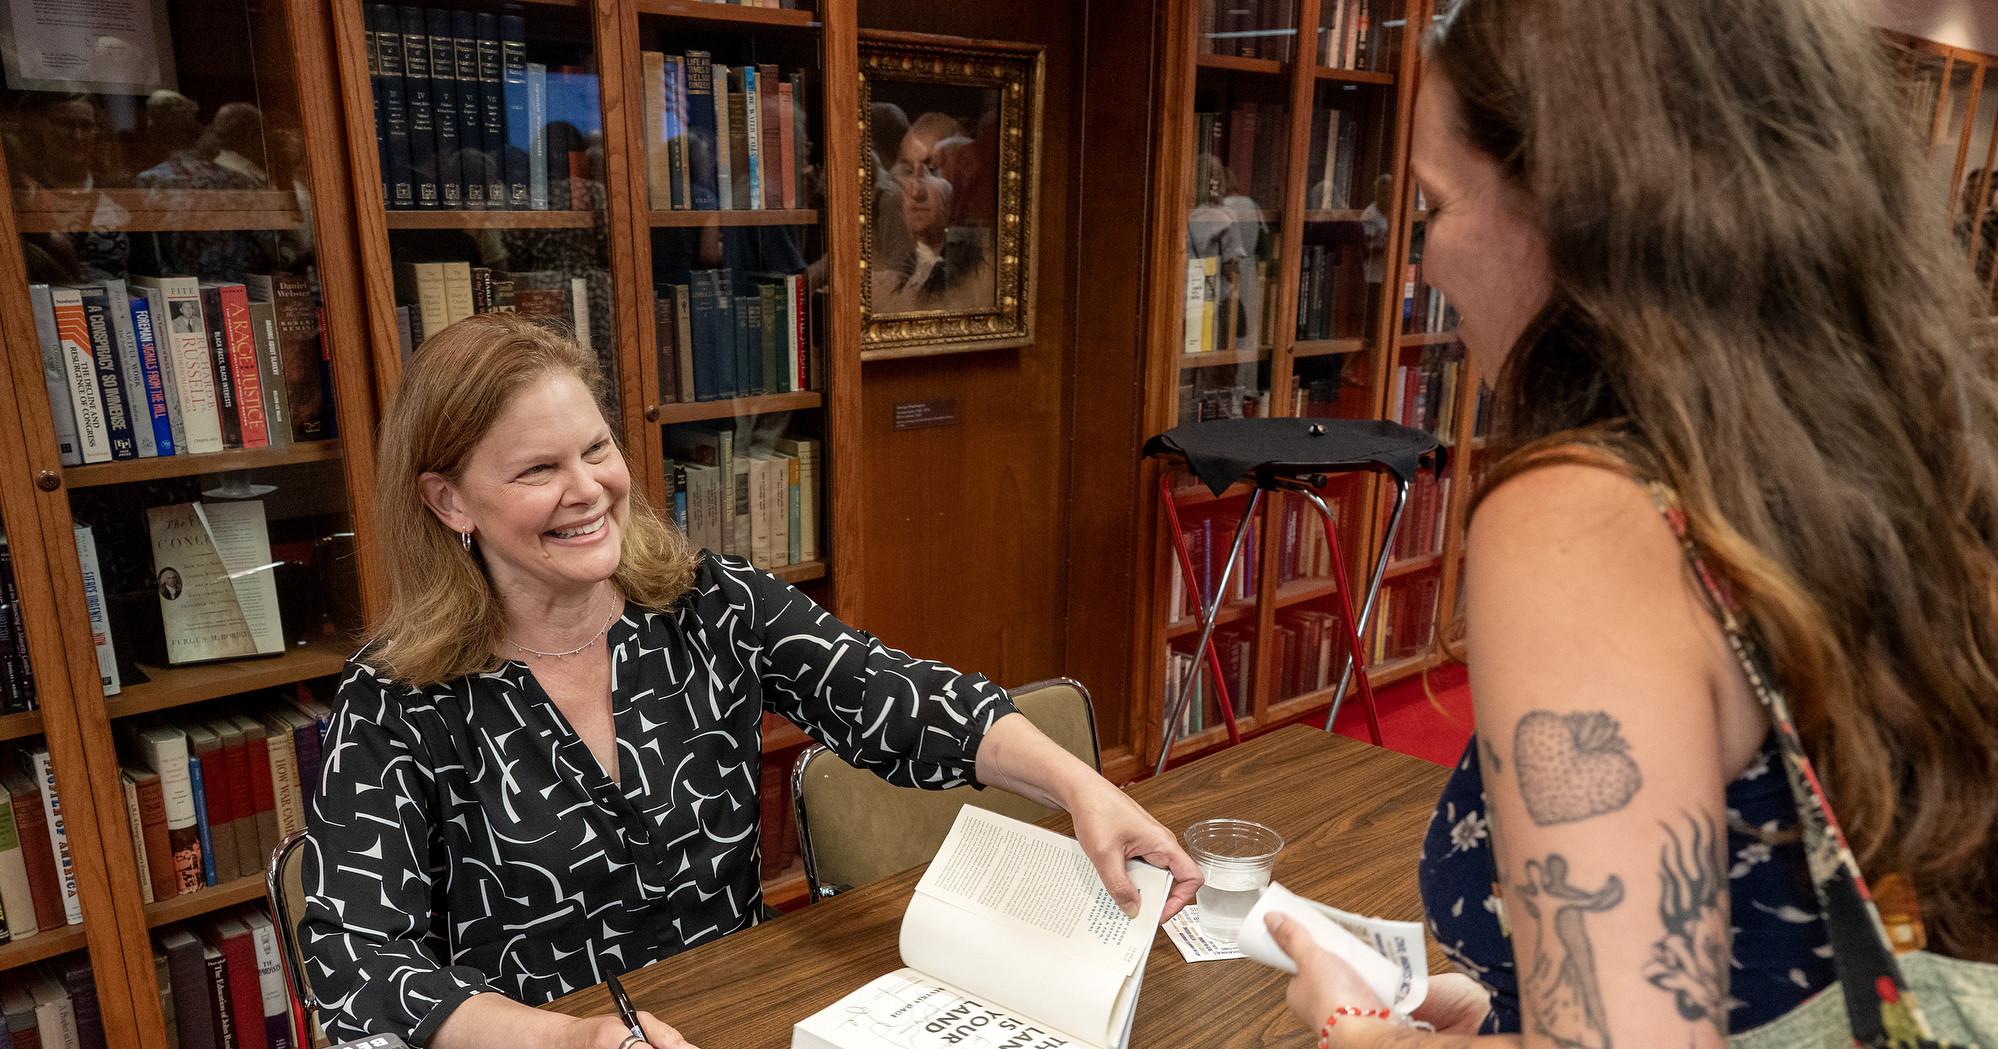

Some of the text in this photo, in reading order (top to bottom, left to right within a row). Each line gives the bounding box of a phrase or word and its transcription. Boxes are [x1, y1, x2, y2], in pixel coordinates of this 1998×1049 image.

[277, 290, 310, 298] Webster
[279, 281, 307, 290] Daniel
[230, 303, 246, 316] A
[233, 320, 254, 365] RAGE
[268, 340, 276, 355] ABOUT
[88, 305, 127, 431] A CONSPIRACY SO IMMENSE
[136, 310, 167, 418] FOREMAN SIGNALS FROM THE HILL
[197, 337, 214, 398] RICHARD
[214, 331, 232, 408] BLACK FACES, BLACK INTERESTS
[270, 355, 279, 376] SLAVERY
[70, 346, 96, 448] RESURGENCE OF CONGRESS
[81, 361, 100, 429] THE DECLINE AND
[241, 370, 263, 430] JUSTICE
[166, 519, 185, 529] The
[157, 534, 211, 549] CONGR
[275, 758, 288, 782] HOW
[279, 782, 293, 808] WAR
[59, 841, 77, 898] AMERICA
[214, 964, 223, 979] The
[216, 979, 228, 1011] Education
[925, 1000, 983, 1033] LAND
[940, 1010, 1005, 1044] YOUR
[998, 1018, 1025, 1031] IS
[997, 1027, 1046, 1049] LAN
